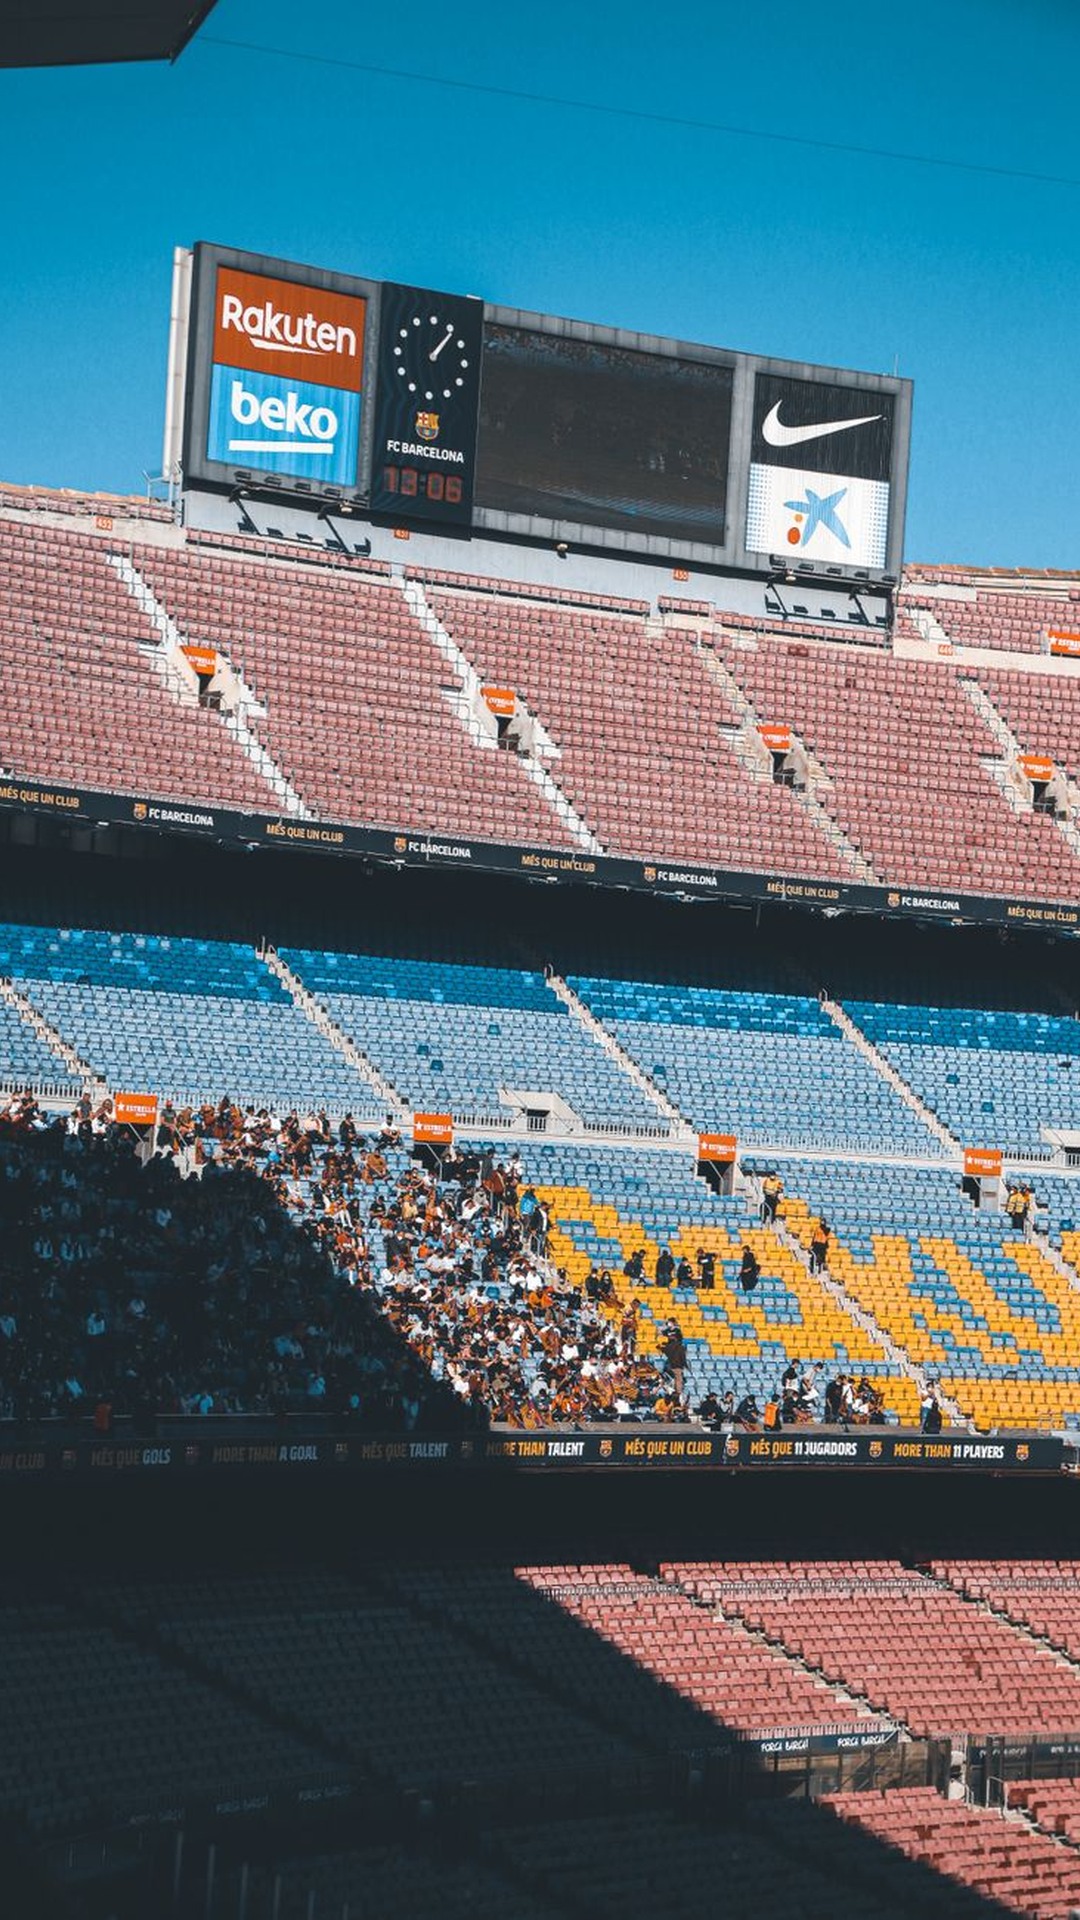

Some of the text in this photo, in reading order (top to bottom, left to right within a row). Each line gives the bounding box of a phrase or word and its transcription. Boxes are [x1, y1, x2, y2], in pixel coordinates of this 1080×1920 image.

[221, 295, 356, 356] Rakuten
[231, 381, 338, 440] beko
[387, 440, 464, 463] FC BARCELONA
[20, 790, 39, 803] QUE
[40, 793, 55, 802] UN
[56, 796, 80, 808] CLUB
[149, 807, 214, 826] FC BARCELONA
[266, 824, 343, 843] MÉS QUE UN CLUB
[408, 841, 471, 858] FC BARCELONA
[521, 854, 596, 872] MÉS QUE UN CLUB
[658, 871, 718, 887] FC BARCELONA
[767, 882, 839, 899] MÉS QUE UN CLUB
[902, 896, 960, 911] FC BARCELONA
[1007, 905, 1078, 922] MÉS QUE UN CLUB
[126, 1105, 156, 1113] ESTRELLA
[423, 1124, 452, 1132] ESTRELLA
[212, 1446, 318, 1463] MORE THAN A GOAL
[362, 1441, 449, 1461] MÉS QUE TALENT
[485, 1441, 585, 1457] MORE THAN TALENT
[624, 1438, 712, 1457] MÉS QUE UN CLUB
[750, 1438, 771, 1455] MÉS
[772, 1442, 793, 1459] QUE
[804, 1441, 857, 1456] JUGADORS
[893, 1443, 922, 1457] MORE
[924, 1444, 950, 1457] THAN
[963, 1444, 1004, 1458] PLAYERS
[91, 1447, 171, 1468] MÉS QUE GOLS
